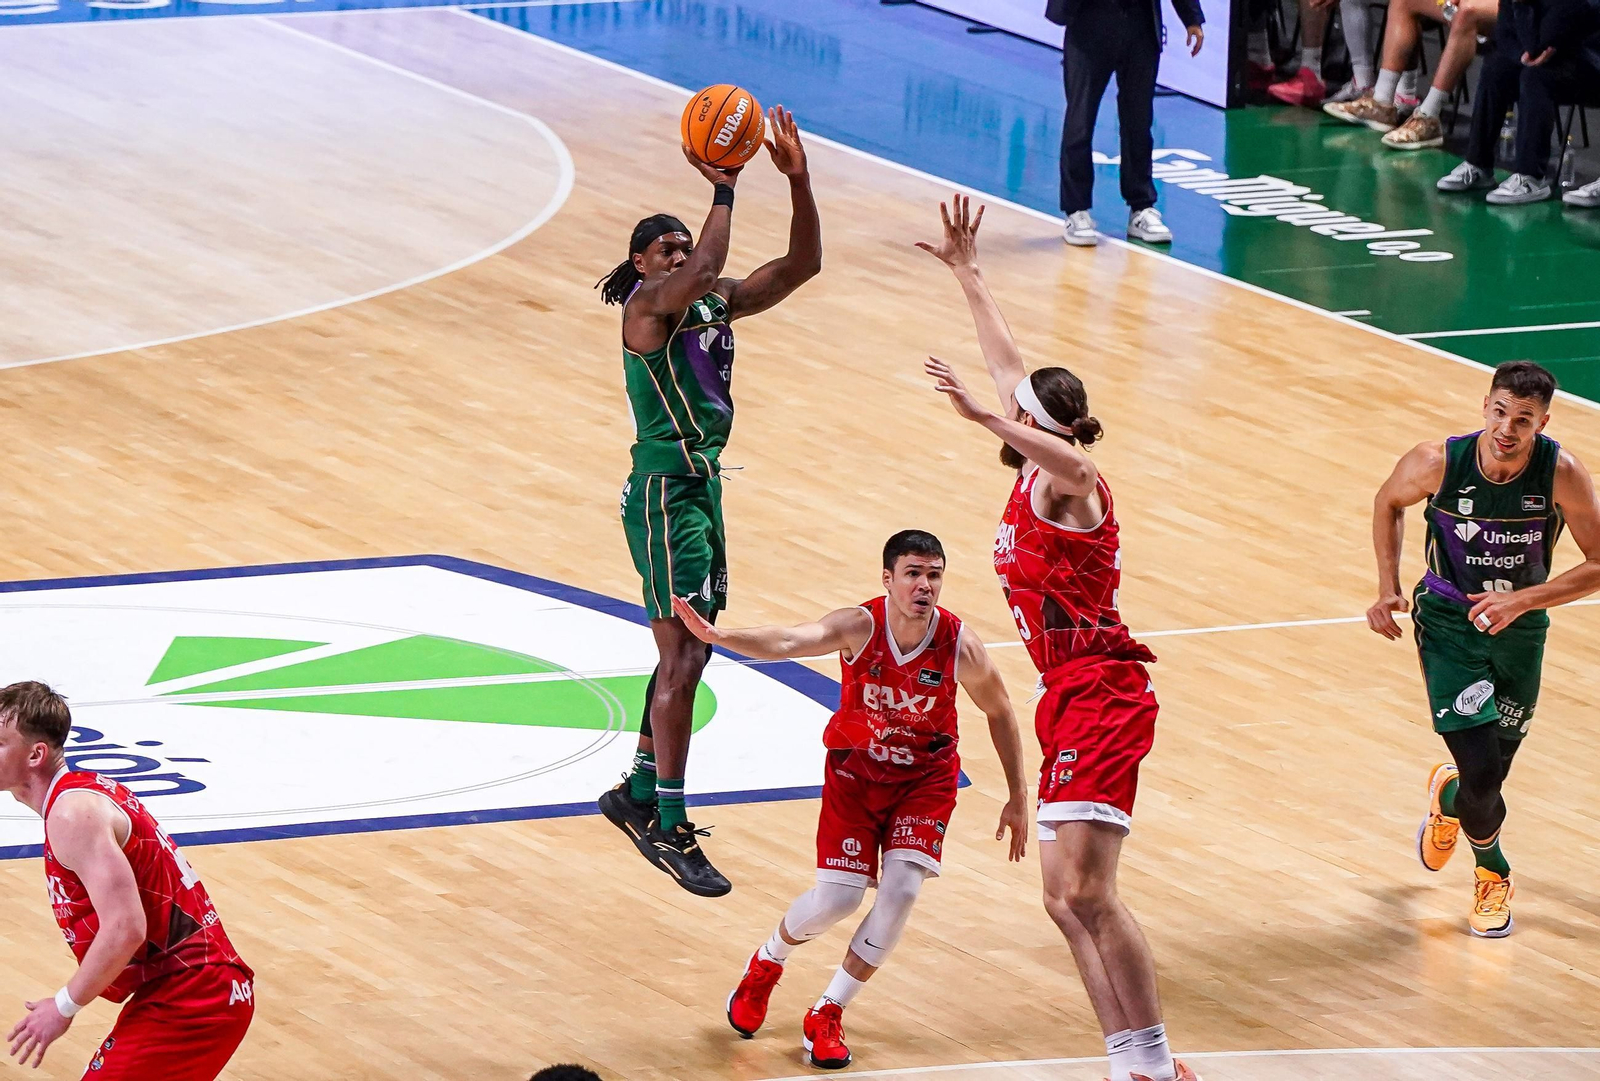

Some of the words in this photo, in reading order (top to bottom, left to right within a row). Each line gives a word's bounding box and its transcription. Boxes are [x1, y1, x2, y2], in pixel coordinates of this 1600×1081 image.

[714, 97, 749, 147] Wilson
[1483, 530, 1542, 545] Unicaja
[863, 682, 937, 715] BAXI
